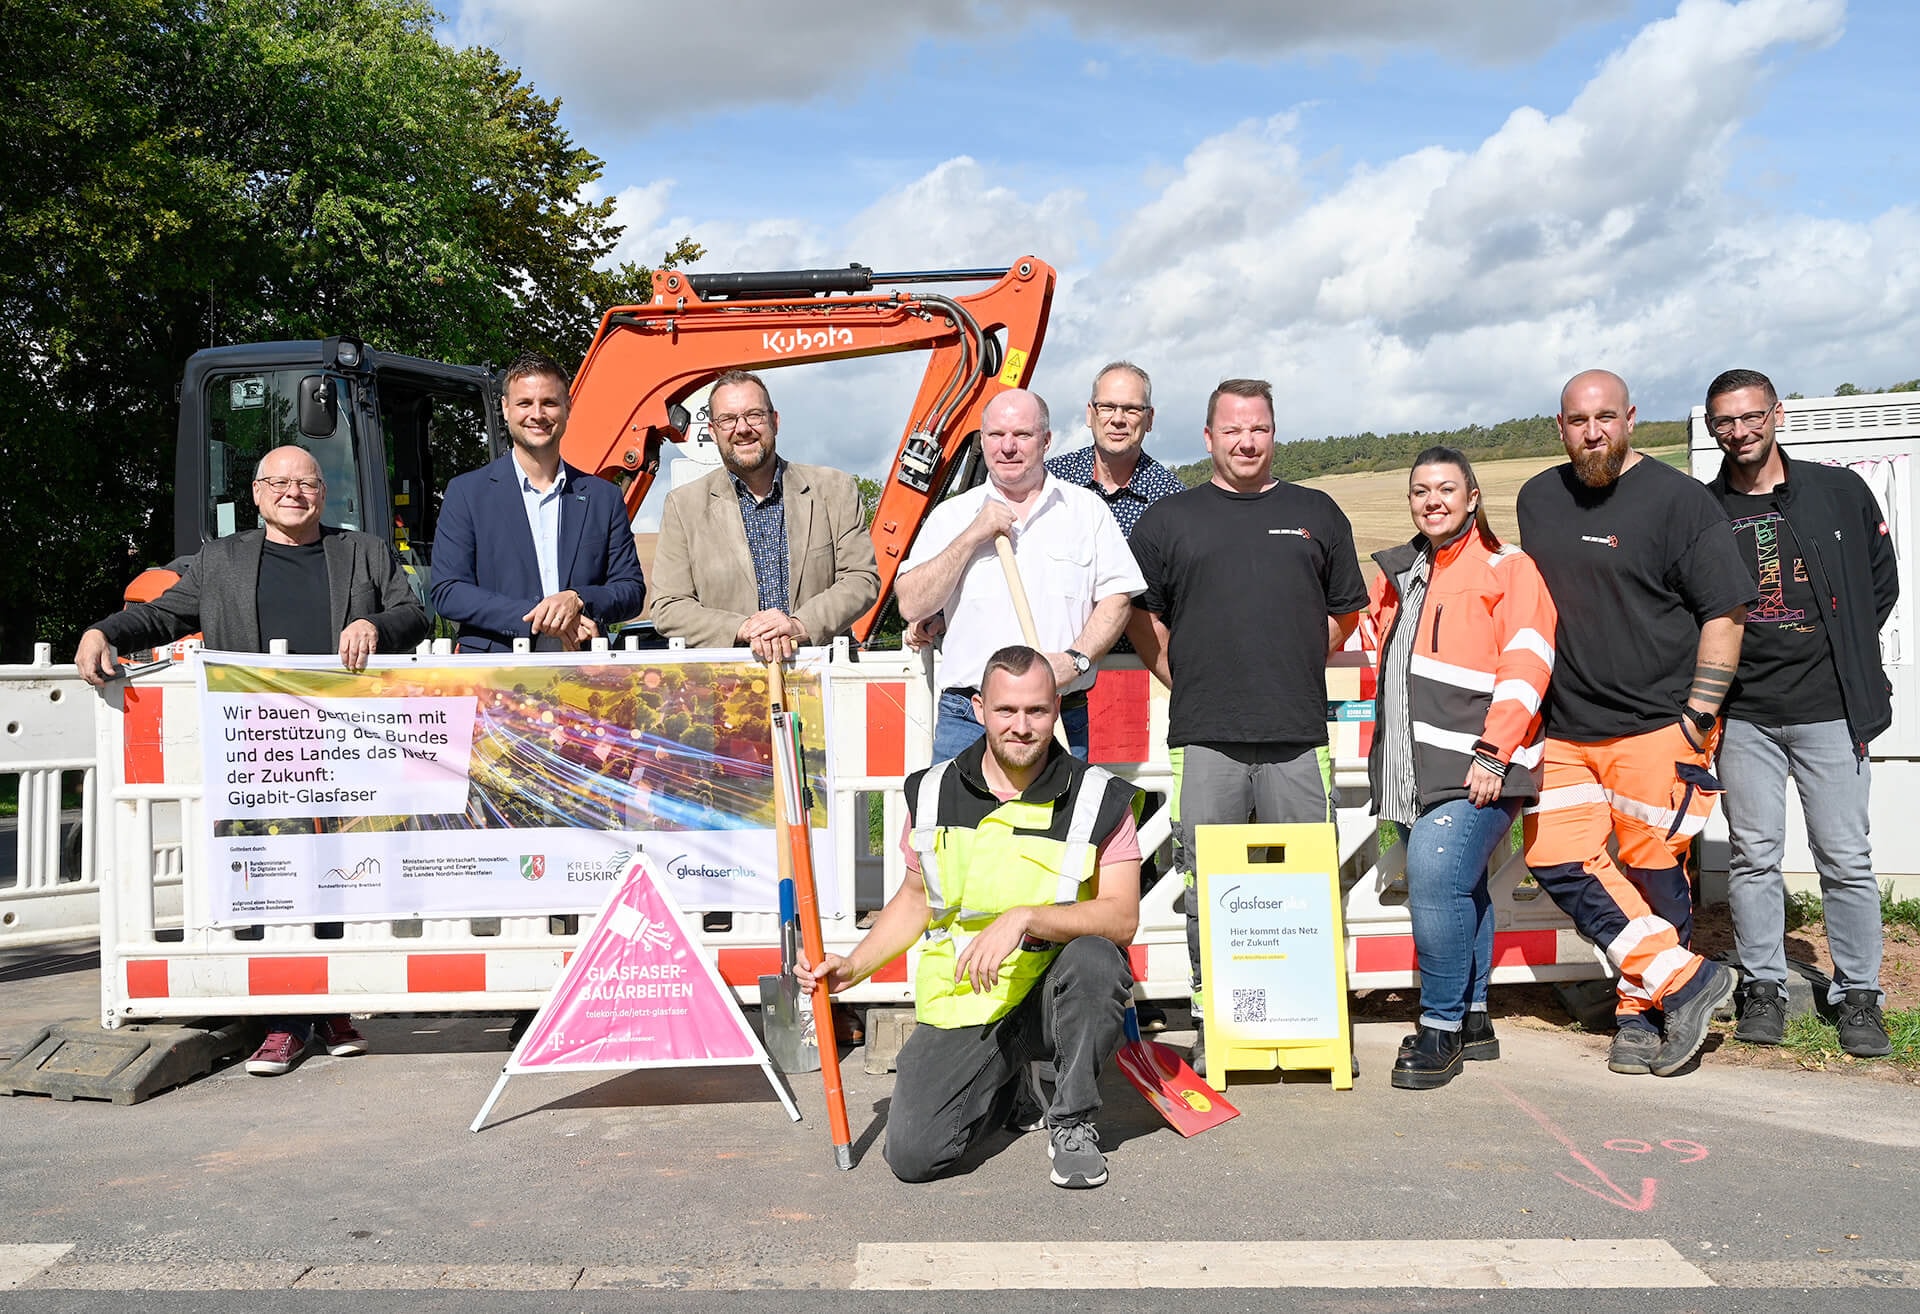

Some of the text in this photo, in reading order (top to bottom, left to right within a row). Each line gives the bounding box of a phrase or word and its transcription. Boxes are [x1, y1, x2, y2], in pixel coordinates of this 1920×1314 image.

[763, 325, 853, 353] Kubota
[223, 706, 447, 725] Wir bauen gemeinsam mit
[224, 726, 347, 743] Unterstützung
[386, 730, 449, 746] Bundes
[226, 746, 438, 763] und des Landes das Netz
[227, 768, 335, 784] der Zukunft:
[228, 788, 377, 809] Gigabit-Glasfaser
[567, 861, 603, 871] KREIS
[676, 864, 757, 880] glasfaserplus
[567, 871, 622, 882] EUSKIRC
[1230, 927, 1319, 936] Hier kommt das Netz
[1230, 938, 1280, 947] der Zukunft
[587, 964, 688, 981] GLASFASER-
[580, 983, 694, 1001] BAUARBEITEN
[585, 1008, 689, 1019] telekom.de/jetzt-glasfaser
